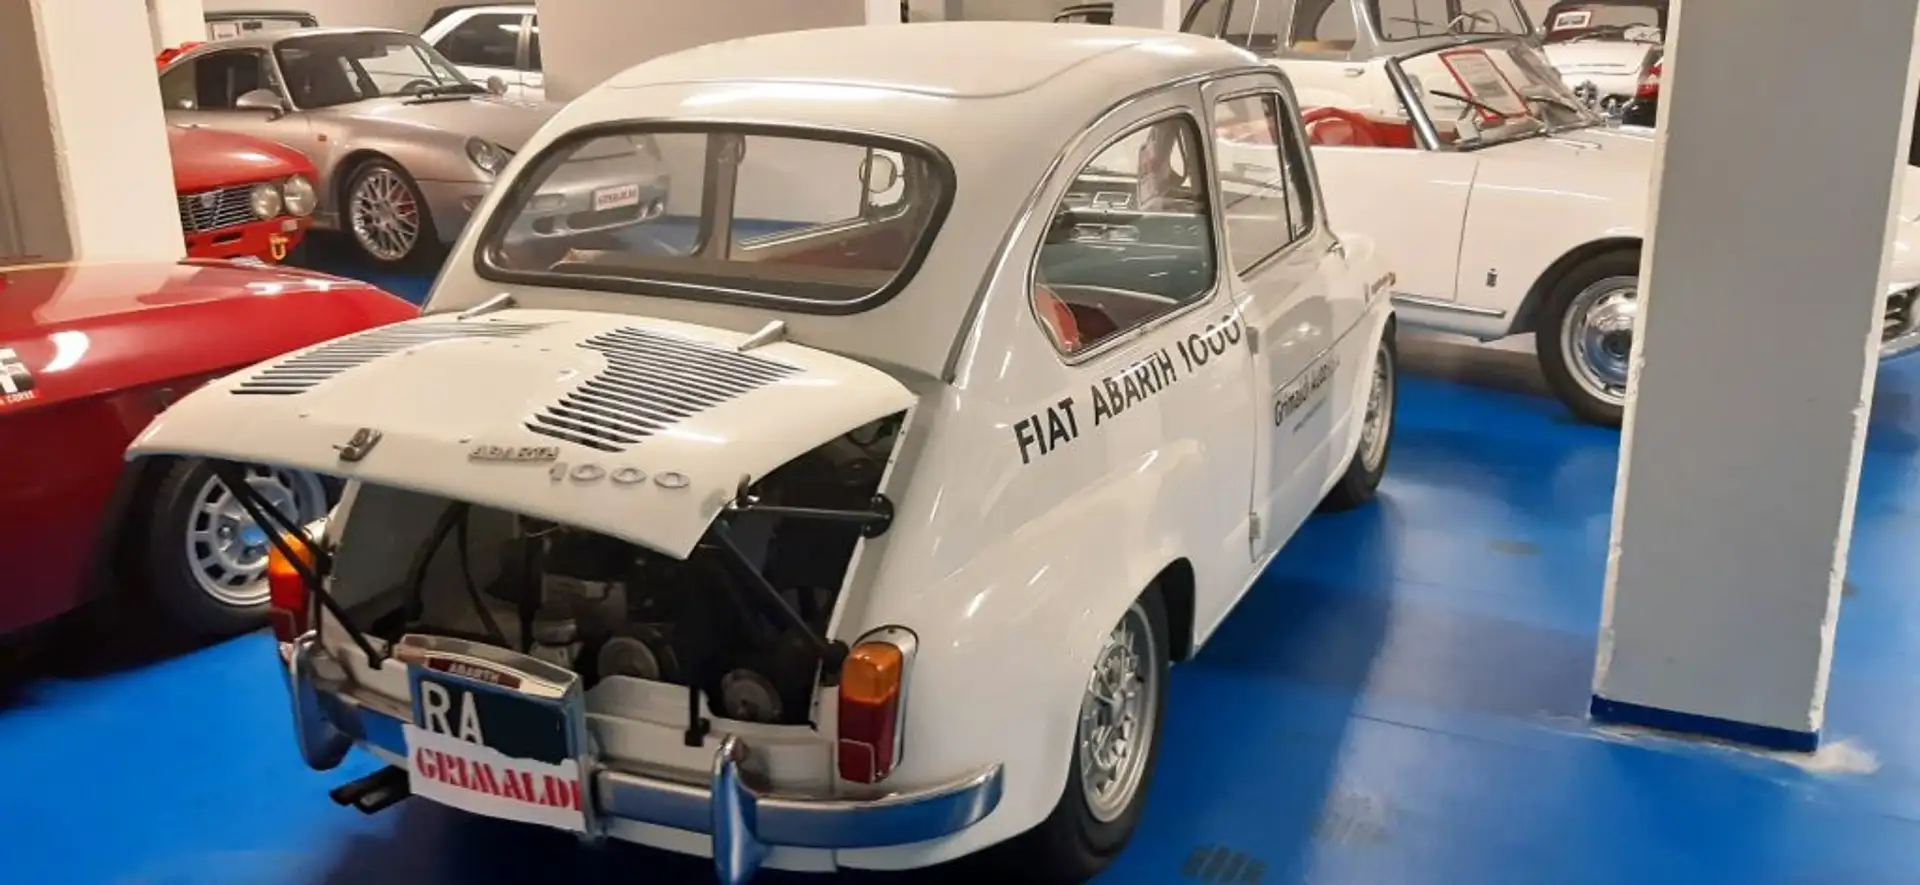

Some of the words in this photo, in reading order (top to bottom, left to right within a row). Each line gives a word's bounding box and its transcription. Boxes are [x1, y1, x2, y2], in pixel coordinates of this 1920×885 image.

[1013, 397, 1079, 464] FIAT
[1090, 348, 1177, 426] ABARTH
[1176, 314, 1241, 373] 1000
[467, 447, 559, 463] ABARTH
[549, 463, 690, 488] 1000
[451, 662, 500, 683] ABARTH
[421, 681, 484, 746] RA
[416, 747, 582, 812] GRIMALDI
